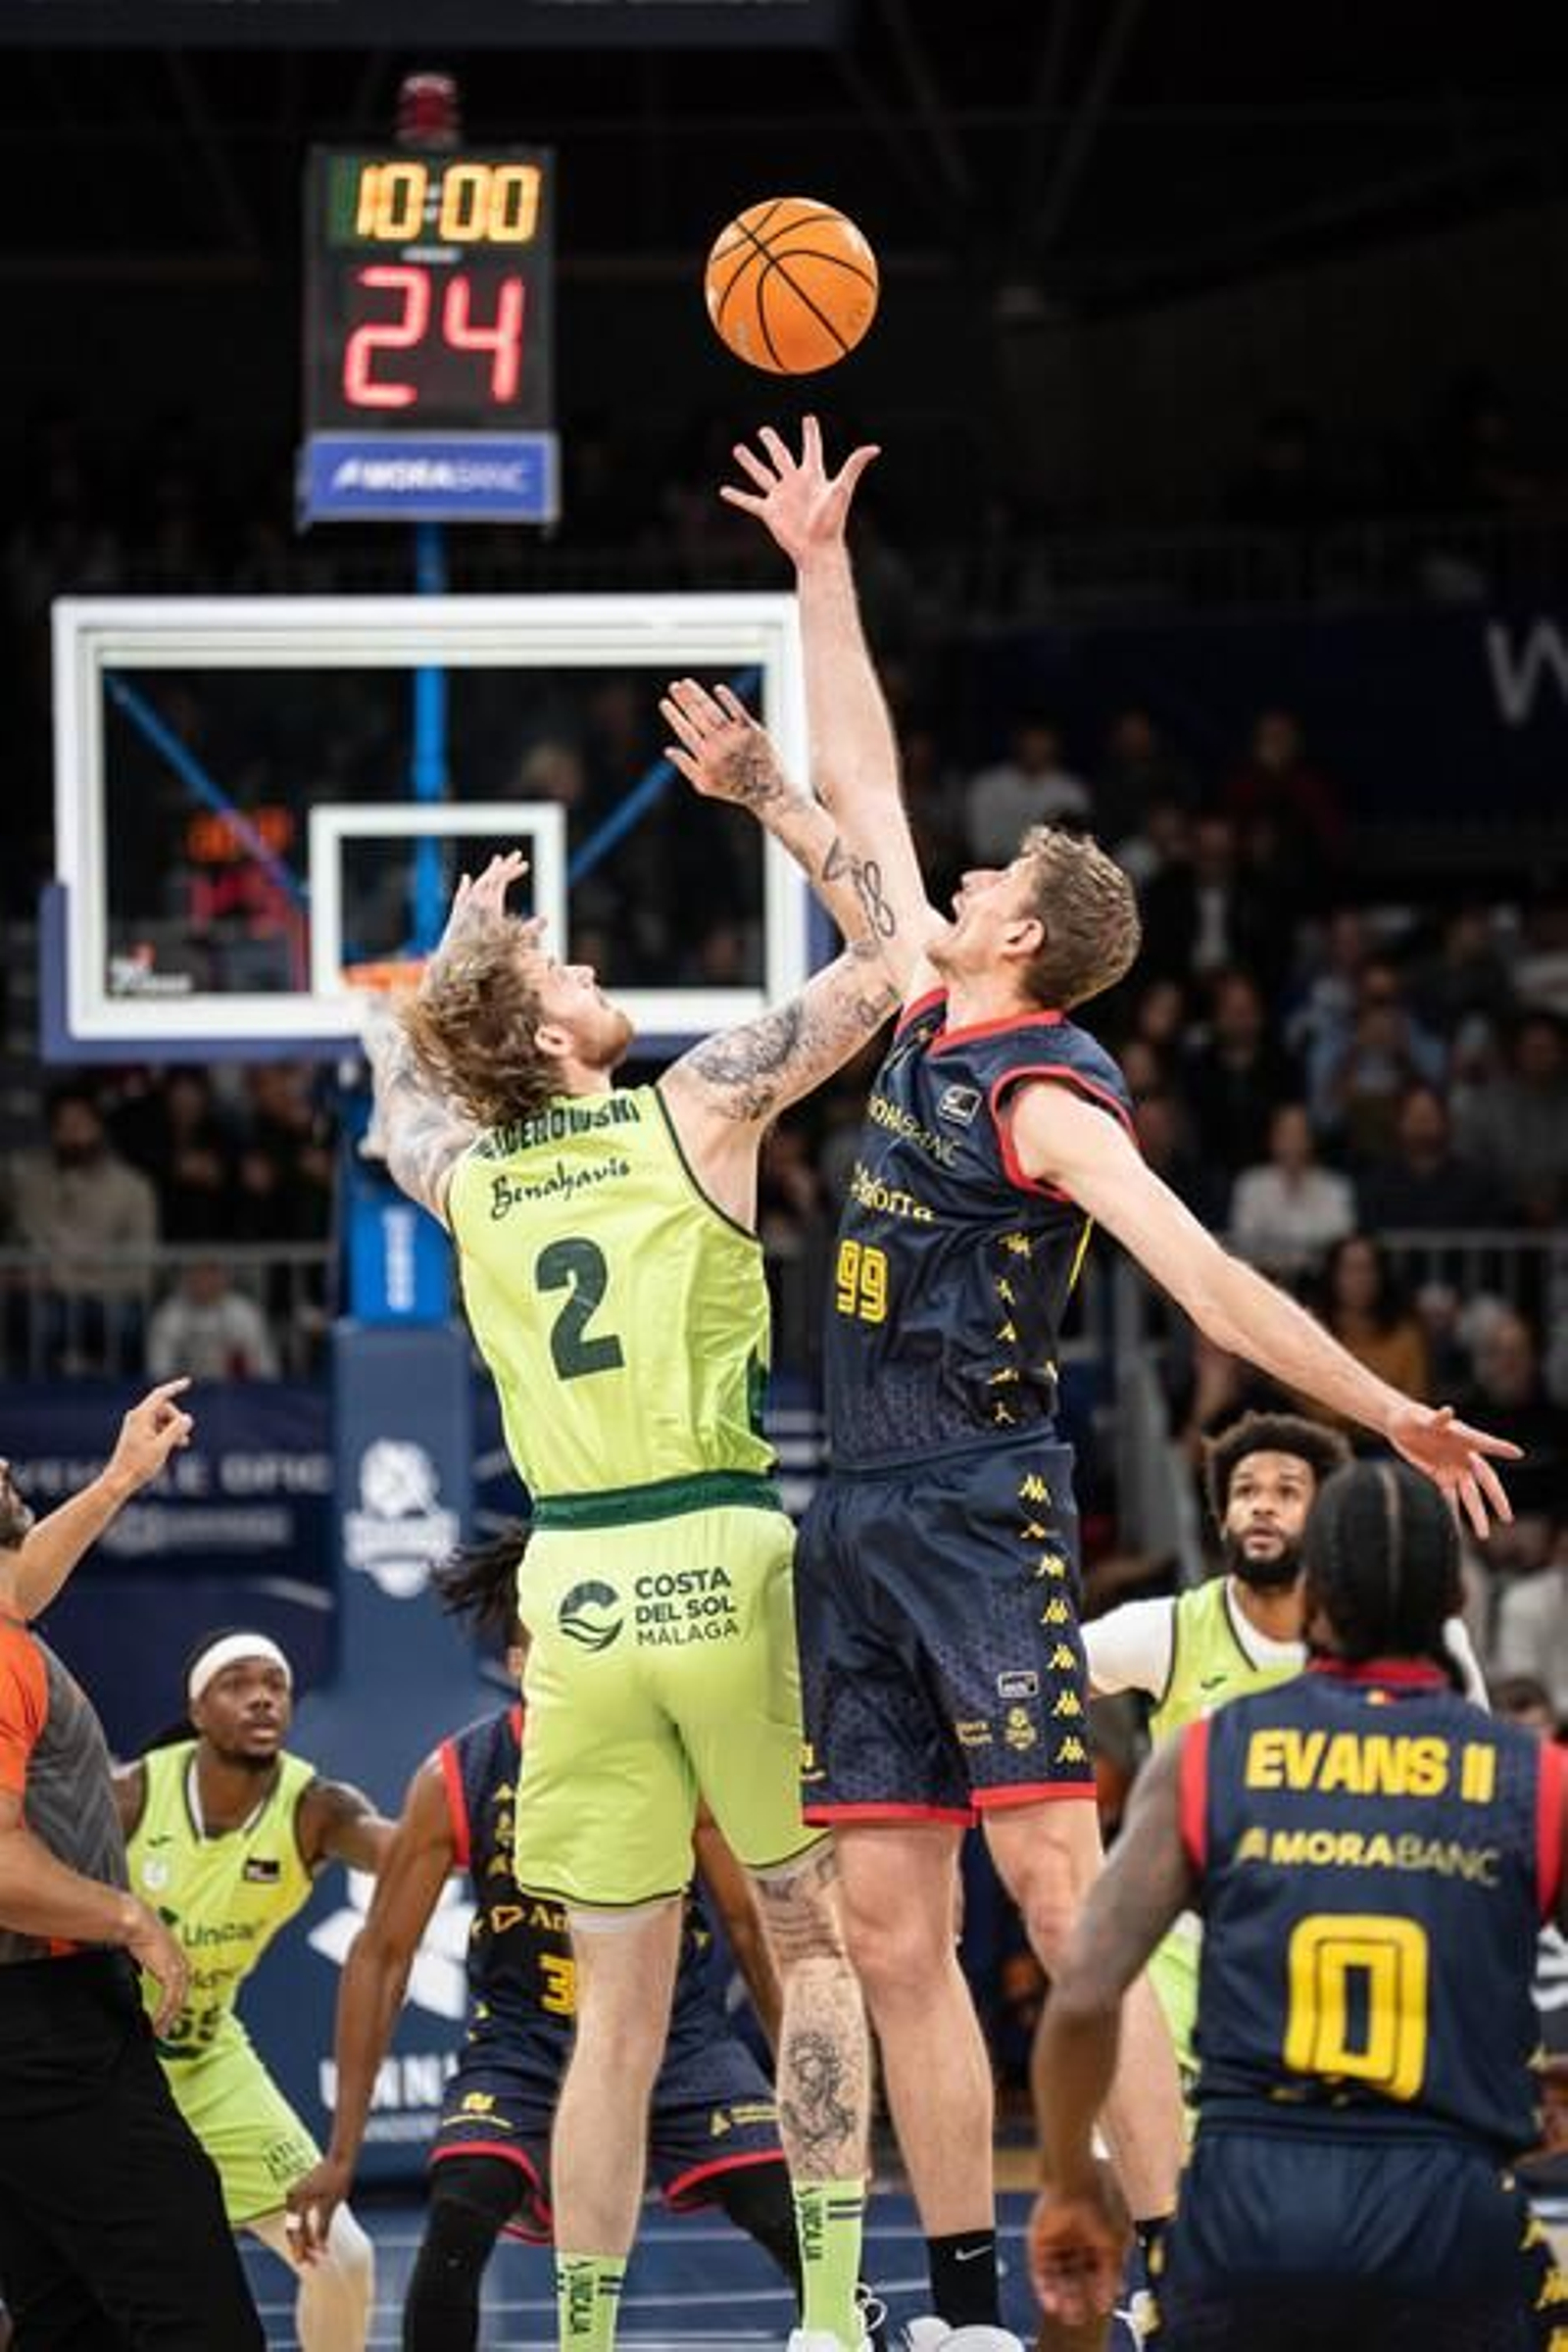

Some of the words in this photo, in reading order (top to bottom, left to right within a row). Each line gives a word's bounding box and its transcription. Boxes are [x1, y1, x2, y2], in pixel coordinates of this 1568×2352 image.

[357, 162, 541, 241] 10:00
[345, 266, 523, 408] 24
[535, 1238, 624, 1381] 2
[836, 1239, 889, 1323] 99
[635, 1567, 732, 1600] COSTA
[635, 1602, 682, 1624] DEL
[687, 1595, 738, 1619] SOL
[1244, 1728, 1449, 1797] EVANS
[1284, 1914, 1428, 2099] 0
